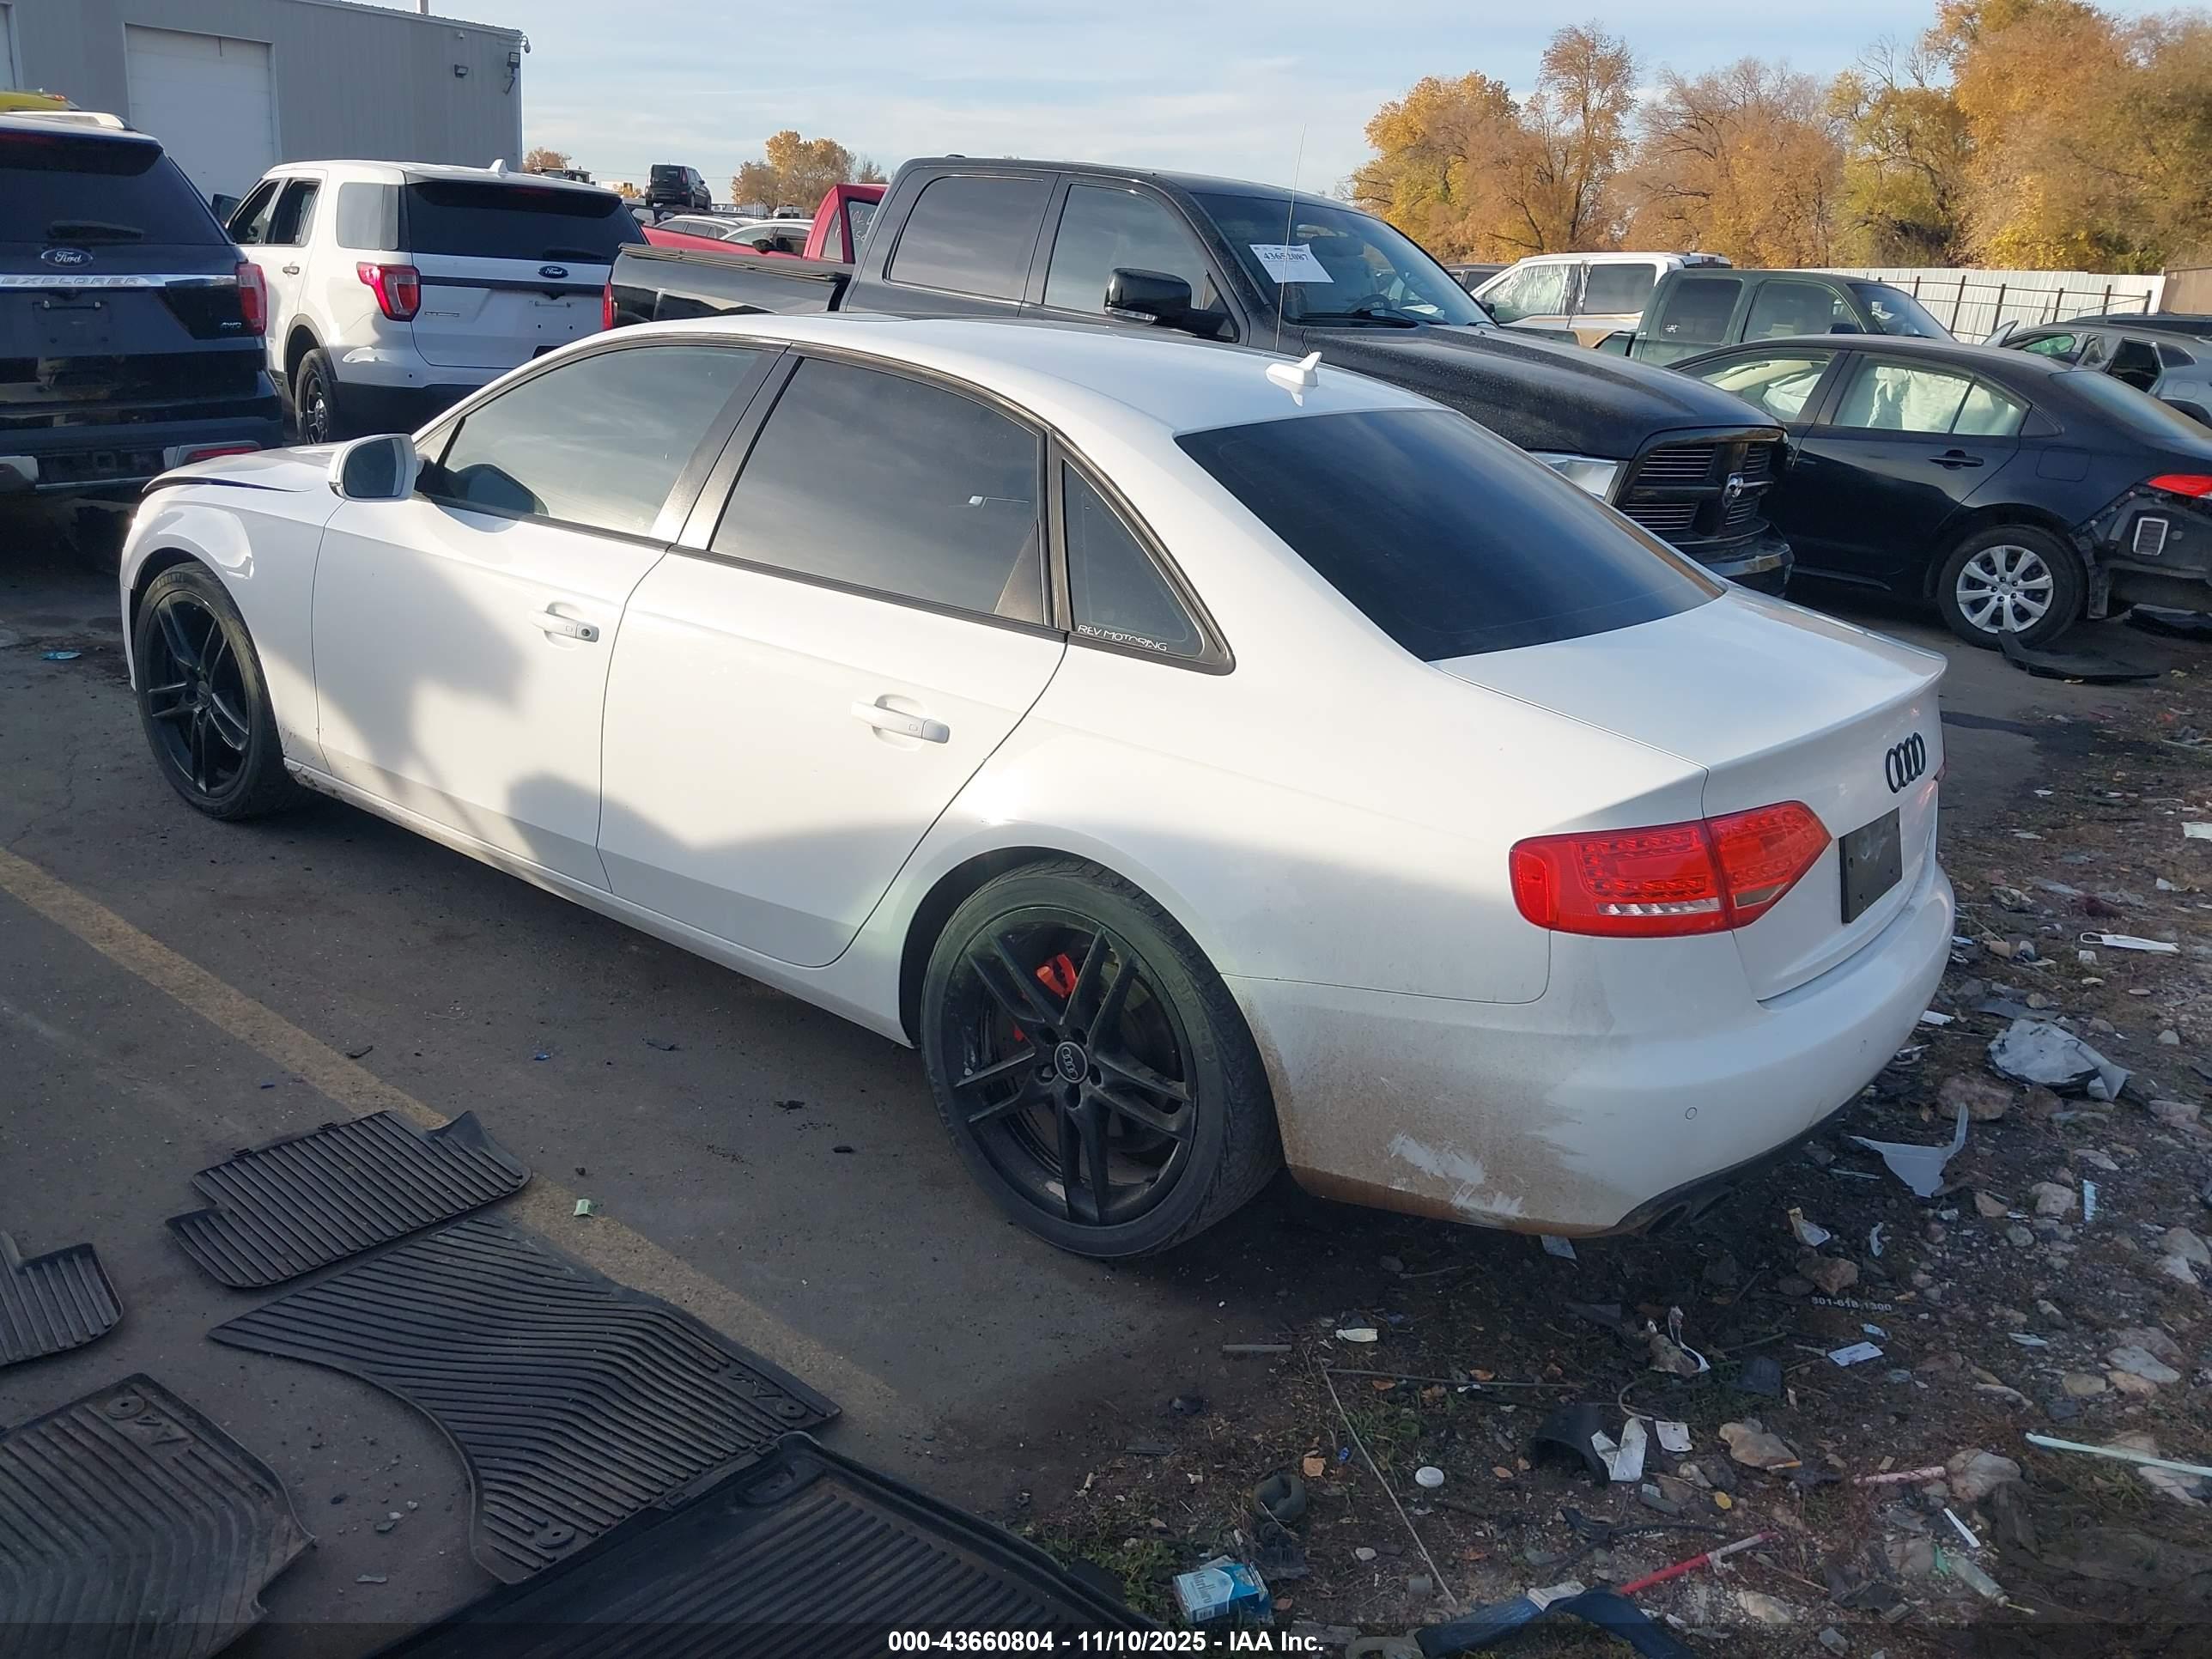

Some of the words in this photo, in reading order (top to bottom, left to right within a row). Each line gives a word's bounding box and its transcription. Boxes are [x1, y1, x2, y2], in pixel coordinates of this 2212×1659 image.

[54, 251, 82, 264] Ford
[544, 266, 563, 275] Ford
[0, 276, 139, 285] EXPLORER
[1078, 624, 1103, 636] REV
[1103, 629, 1169, 652] MOTORING
